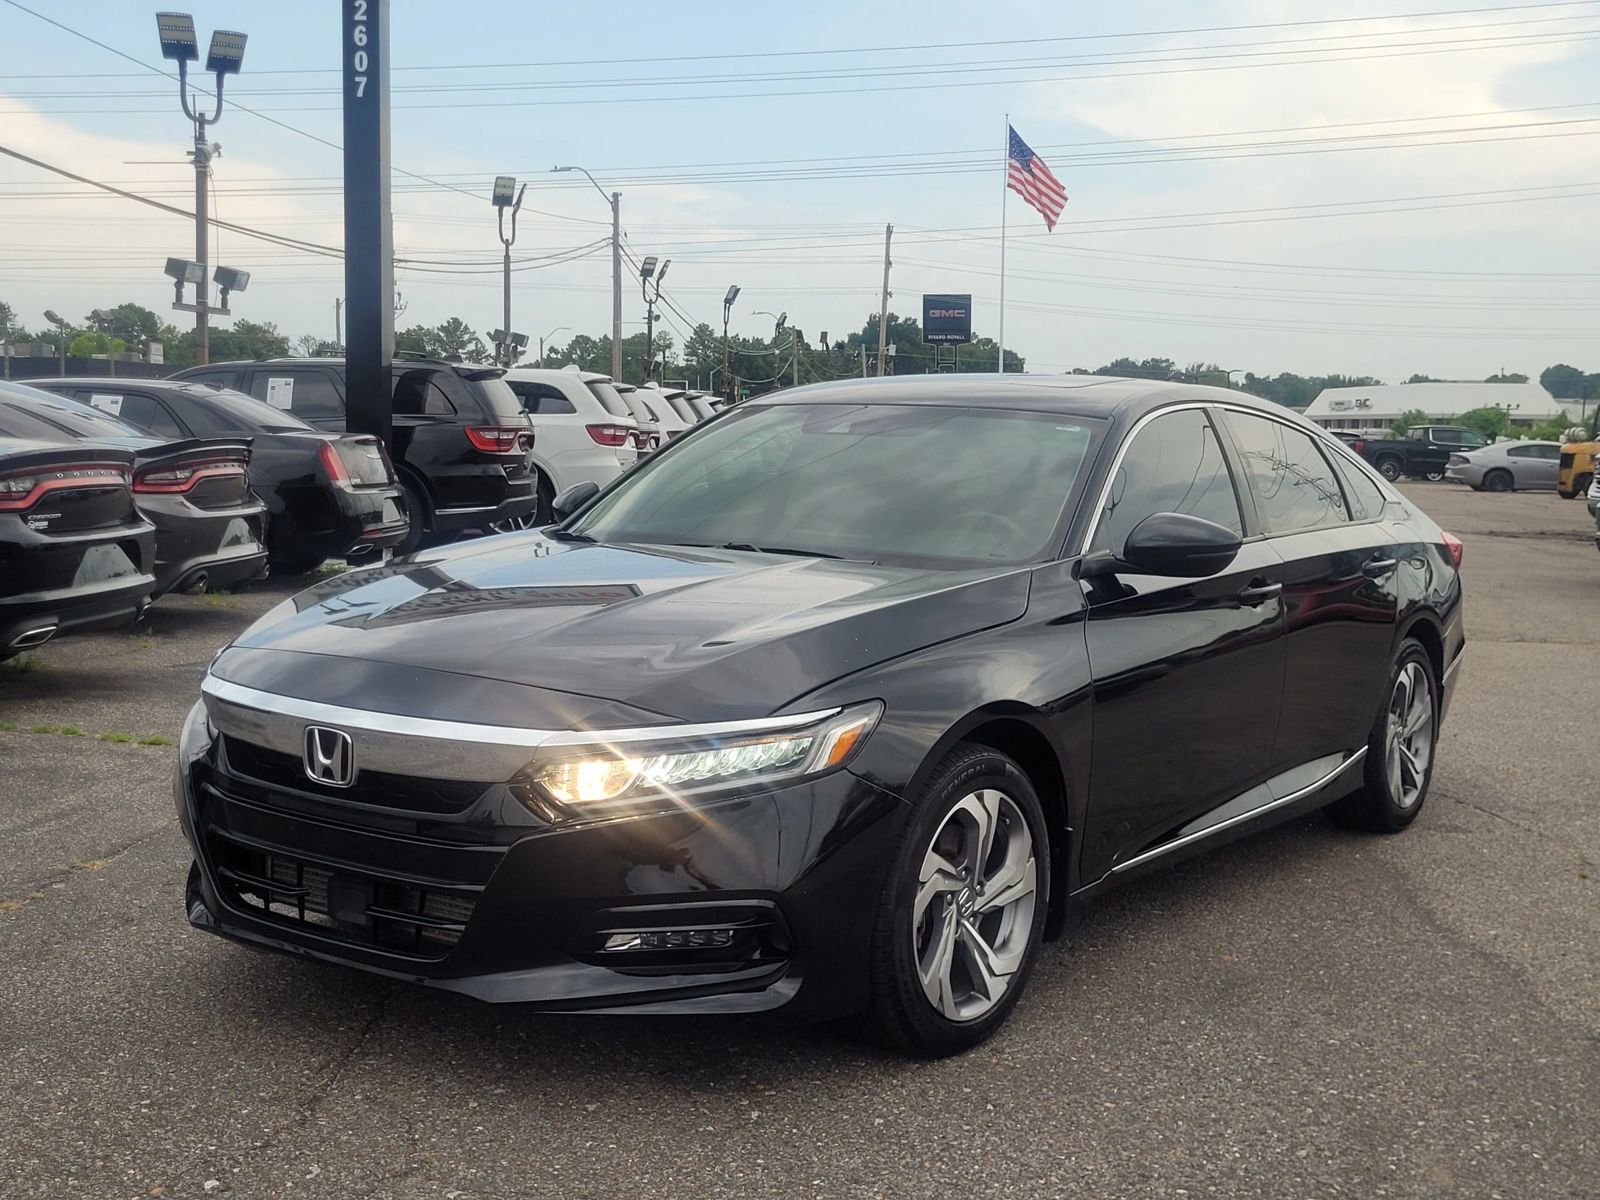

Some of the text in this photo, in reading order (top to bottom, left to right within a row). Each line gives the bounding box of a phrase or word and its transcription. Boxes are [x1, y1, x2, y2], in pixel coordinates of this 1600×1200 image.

[354, 0, 368, 97] 2607
[929, 309, 966, 317] GMC
[941, 763, 987, 799] GENERAL
